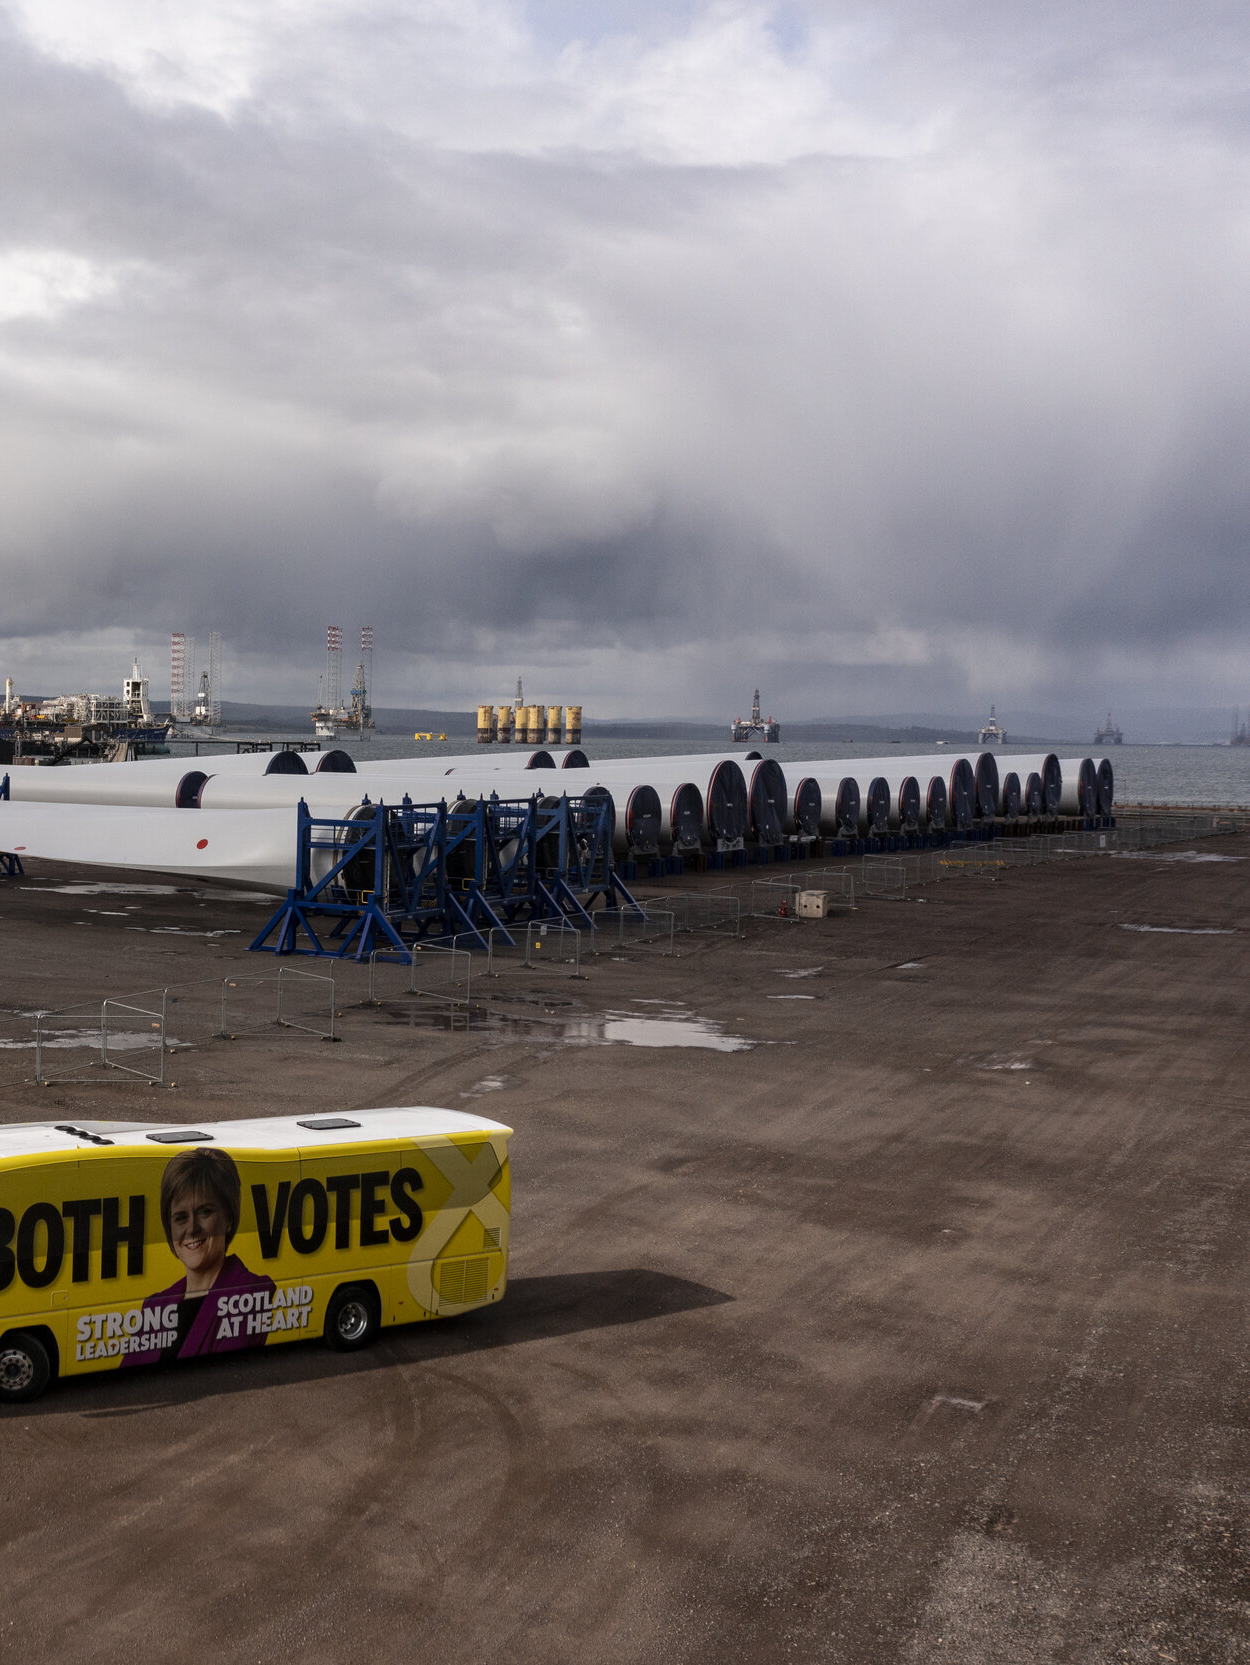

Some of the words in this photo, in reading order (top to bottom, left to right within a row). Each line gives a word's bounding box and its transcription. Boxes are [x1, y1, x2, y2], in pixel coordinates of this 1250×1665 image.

[251, 1167, 424, 1260] VOTES
[217, 1286, 313, 1316] SCOTLAND
[76, 1304, 179, 1342] STRONG
[216, 1314, 243, 1339] AT
[247, 1306, 312, 1336] HEART
[76, 1331, 178, 1361] LEADERSHIP
